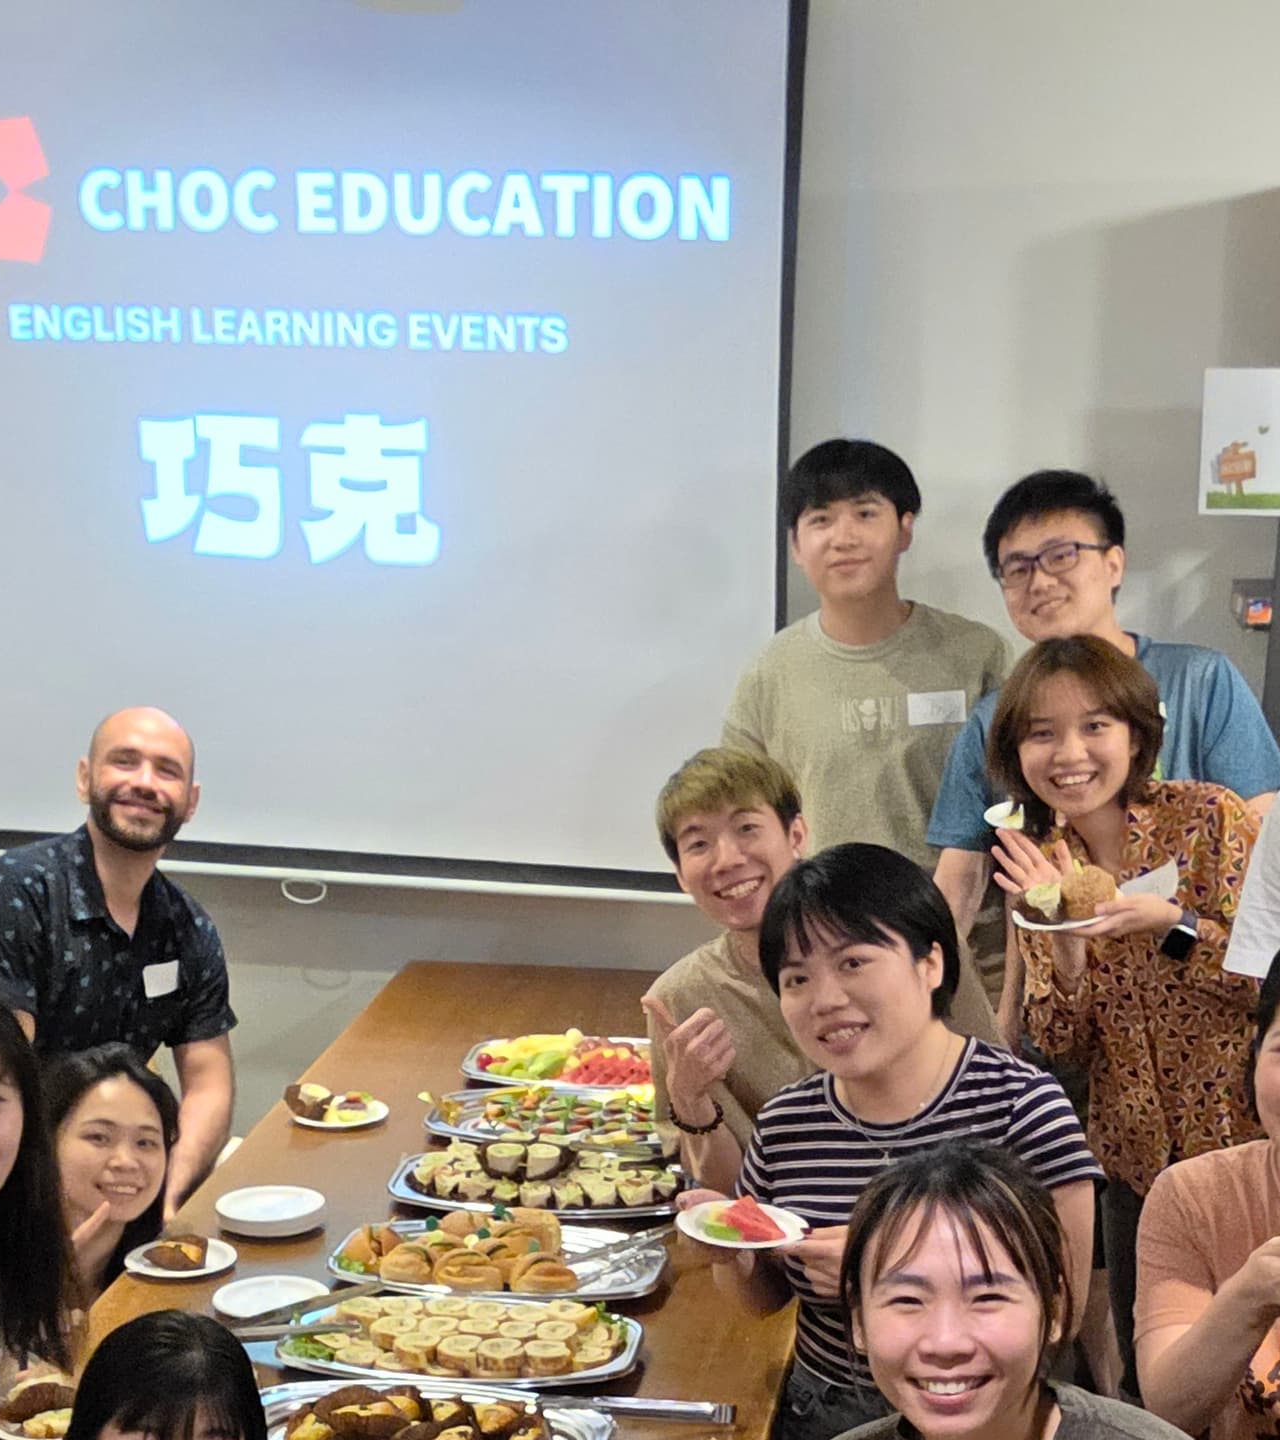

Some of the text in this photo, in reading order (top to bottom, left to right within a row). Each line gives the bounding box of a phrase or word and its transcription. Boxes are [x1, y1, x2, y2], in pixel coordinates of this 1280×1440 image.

[79, 169, 732, 242] CHOC EDUCATION
[8, 303, 569, 354] ENGLISH LEARNING EVENTS
[139, 412, 442, 567] 巧克
